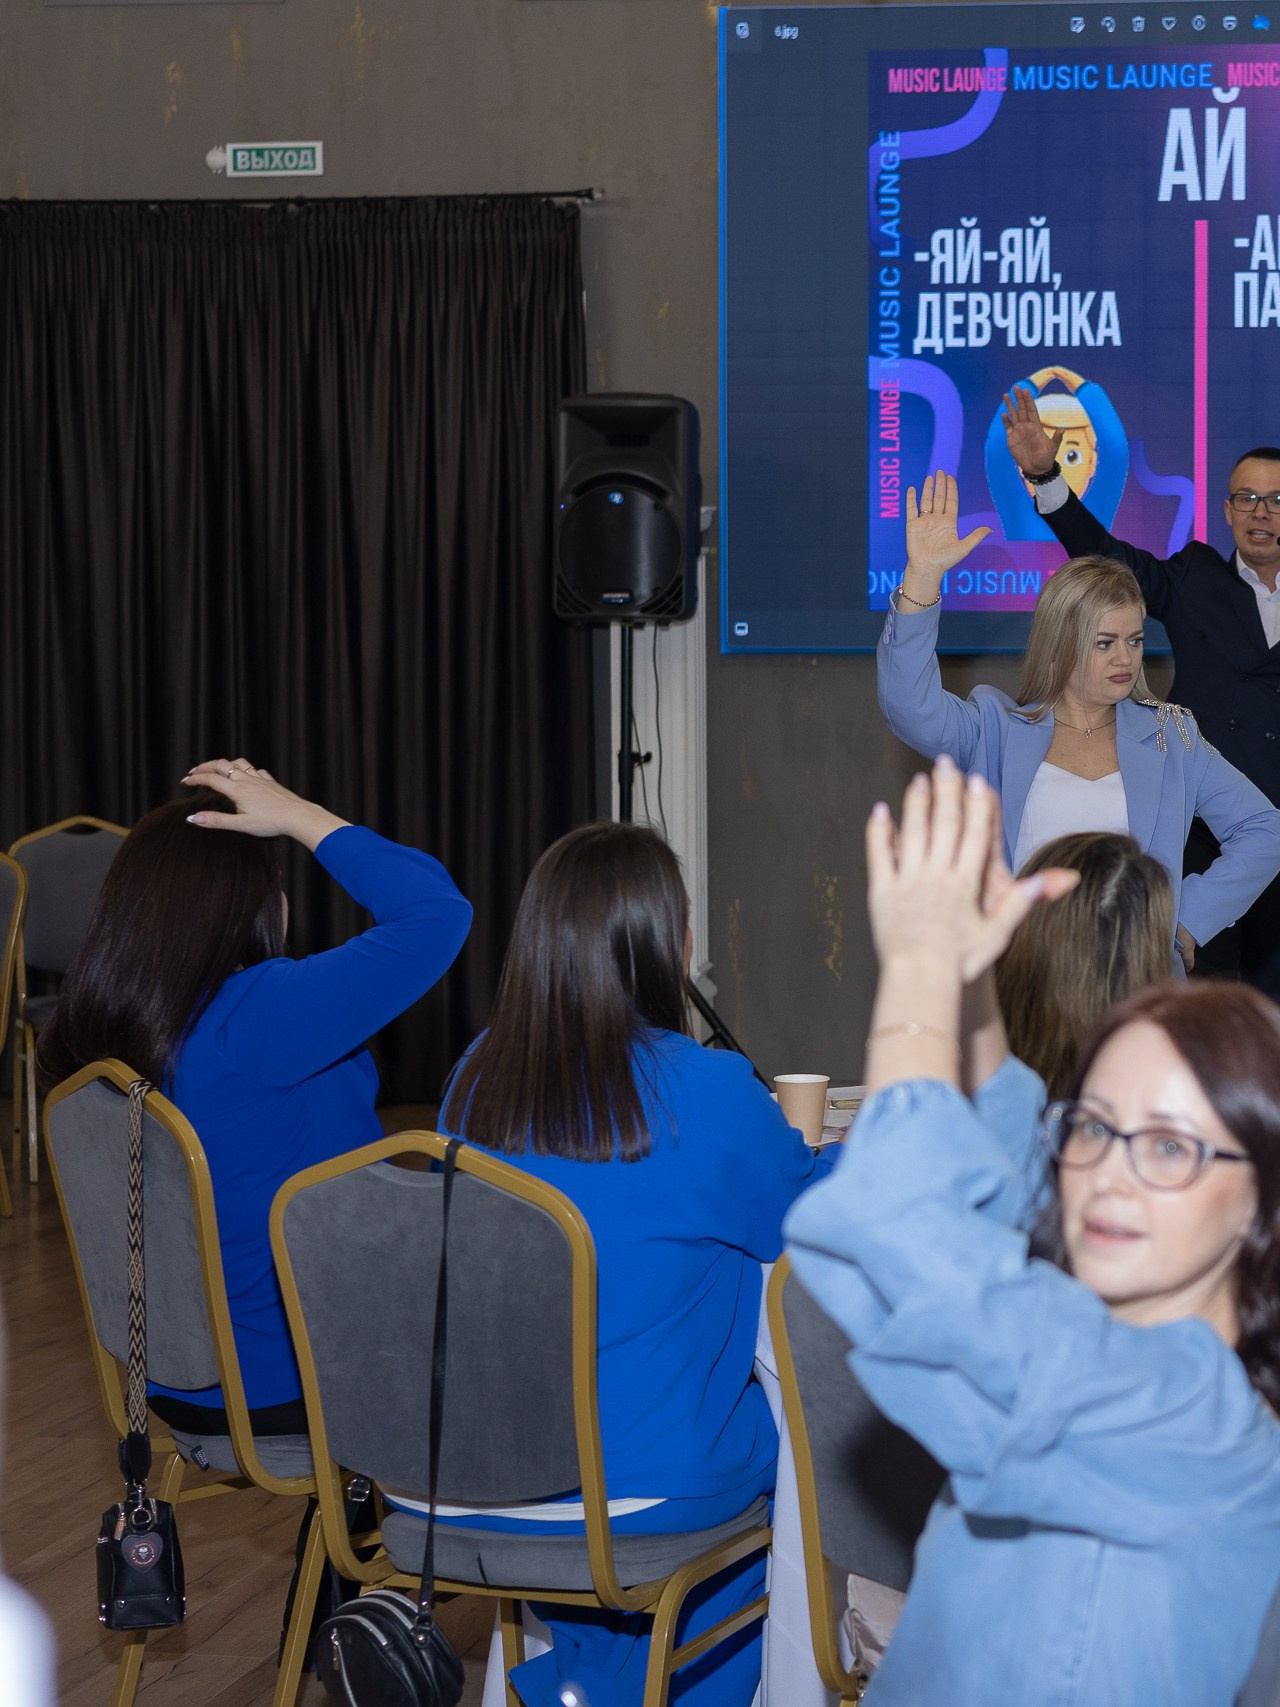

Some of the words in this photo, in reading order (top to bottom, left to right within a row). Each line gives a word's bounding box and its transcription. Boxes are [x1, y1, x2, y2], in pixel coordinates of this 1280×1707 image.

[888, 68, 940, 93] MUSIC
[943, 67, 1008, 92] LAUNGE
[1013, 65, 1099, 91] MUSIC
[1106, 64, 1214, 89] LAUNGE
[1227, 62, 1280, 87] MUSIC
[236, 149, 314, 170] ВЫХОД
[1157, 86, 1246, 202] АЙ
[879, 130, 901, 258] LAUNGE
[913, 216, 1063, 291] -ЯЙ-ЯЙ,
[879, 266, 900, 369] MUSIC
[912, 290, 1123, 355] ДЕВЧОНКА
[879, 377, 900, 453] LAUNGE
[879, 463, 900, 519] MUSIC
[957, 569, 1042, 594] MUSIC
